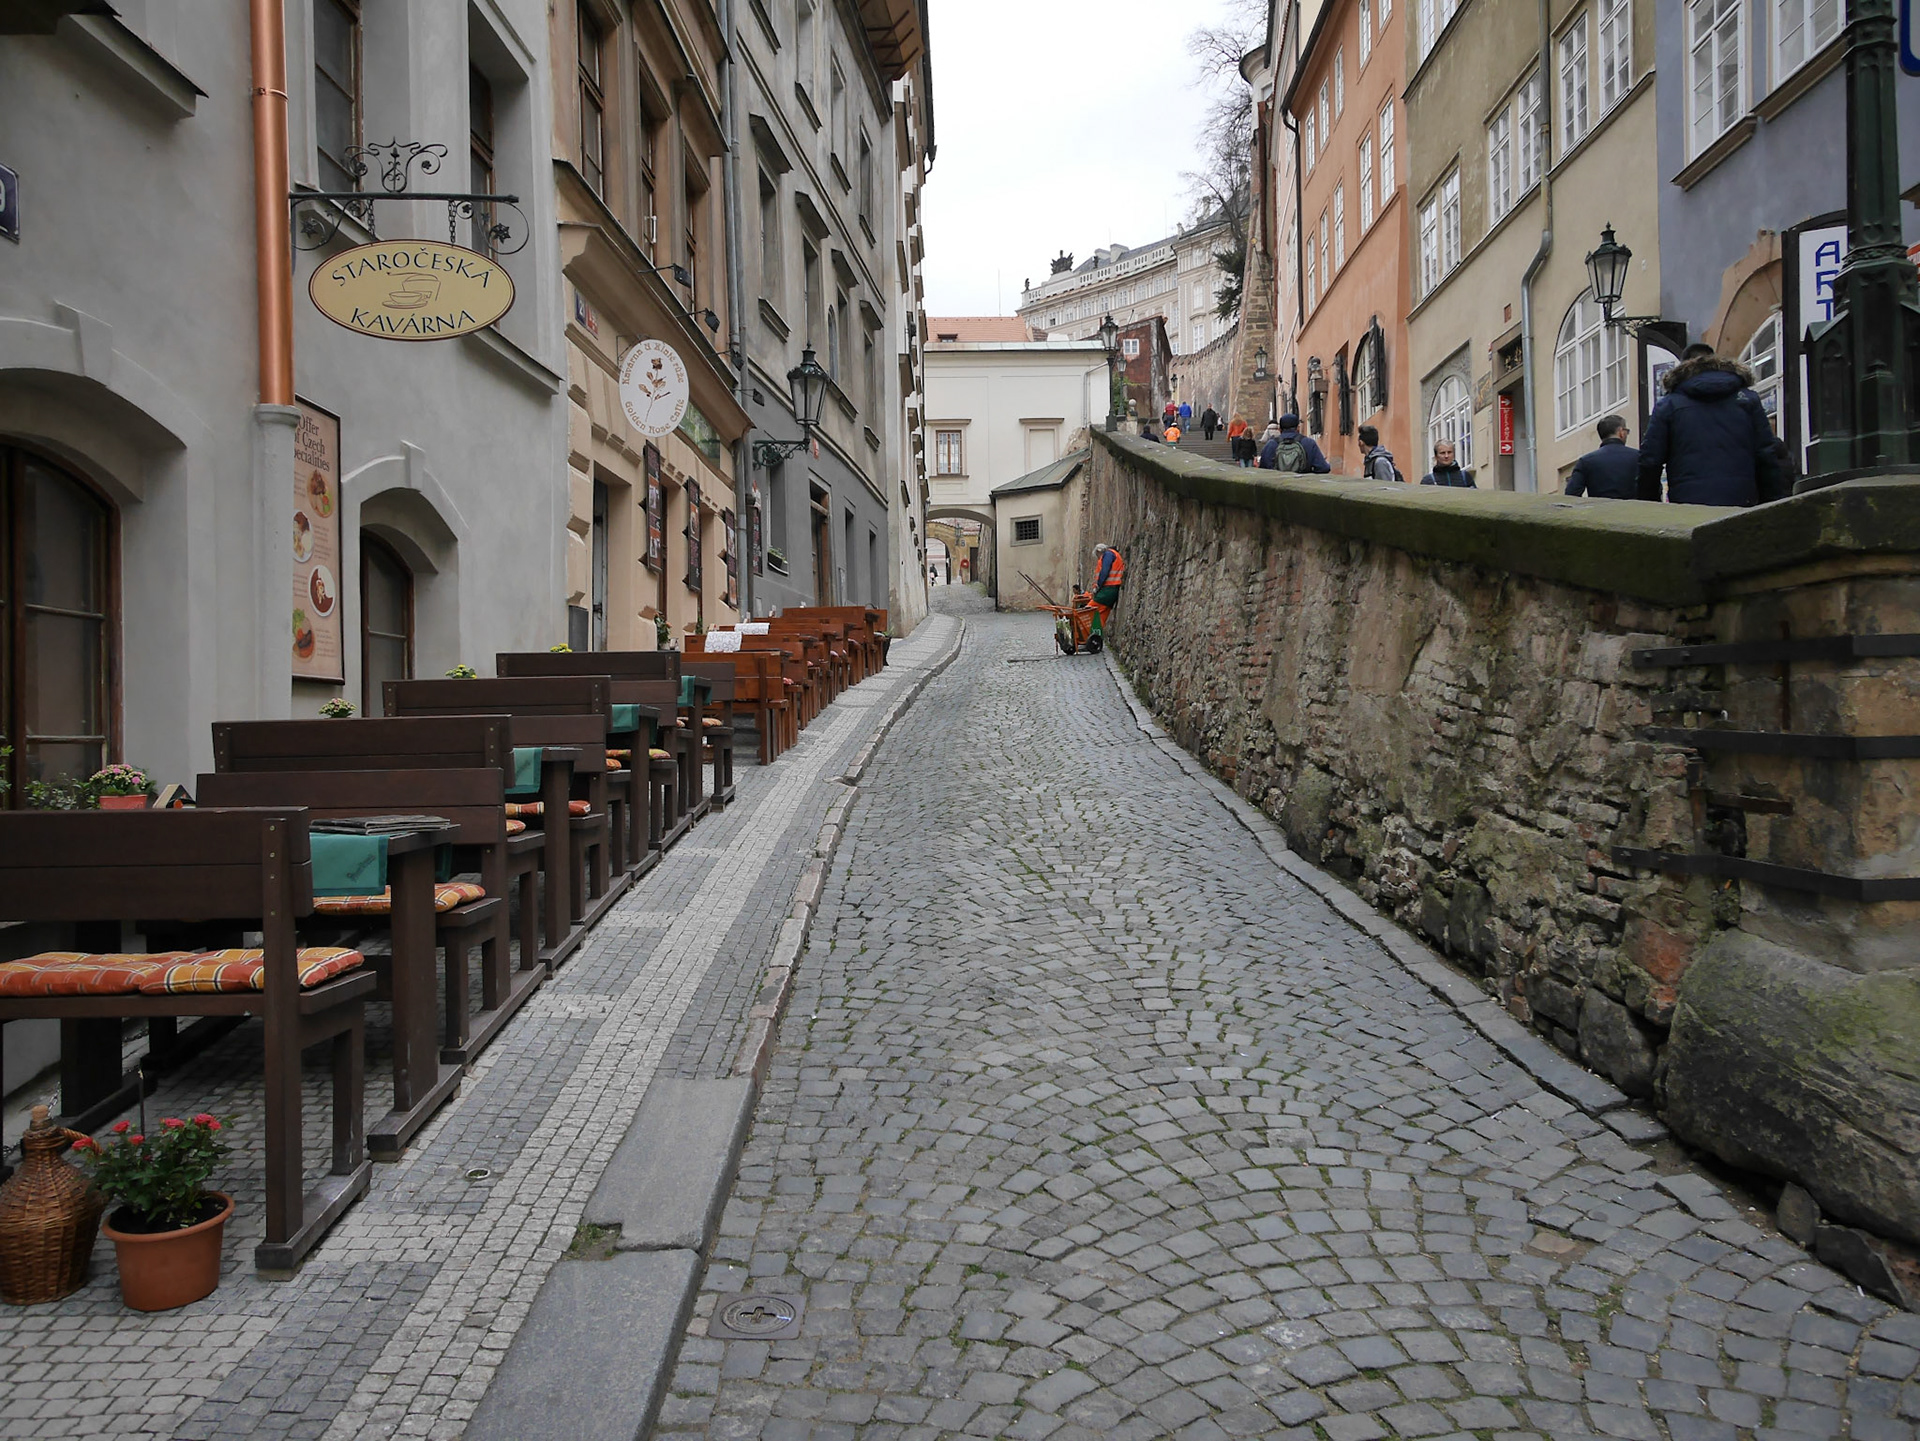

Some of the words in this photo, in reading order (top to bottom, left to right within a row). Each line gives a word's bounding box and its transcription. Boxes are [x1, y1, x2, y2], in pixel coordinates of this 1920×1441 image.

[332, 247, 494, 288] STAROČESKÁ
[351, 308, 476, 334] KAVÁRNA
[298, 413, 319, 436] Offer
[625, 401, 646, 431] Golden
[648, 424, 671, 435] Rose
[302, 431, 326, 455] Czech
[294, 448, 330, 472] ecialities
